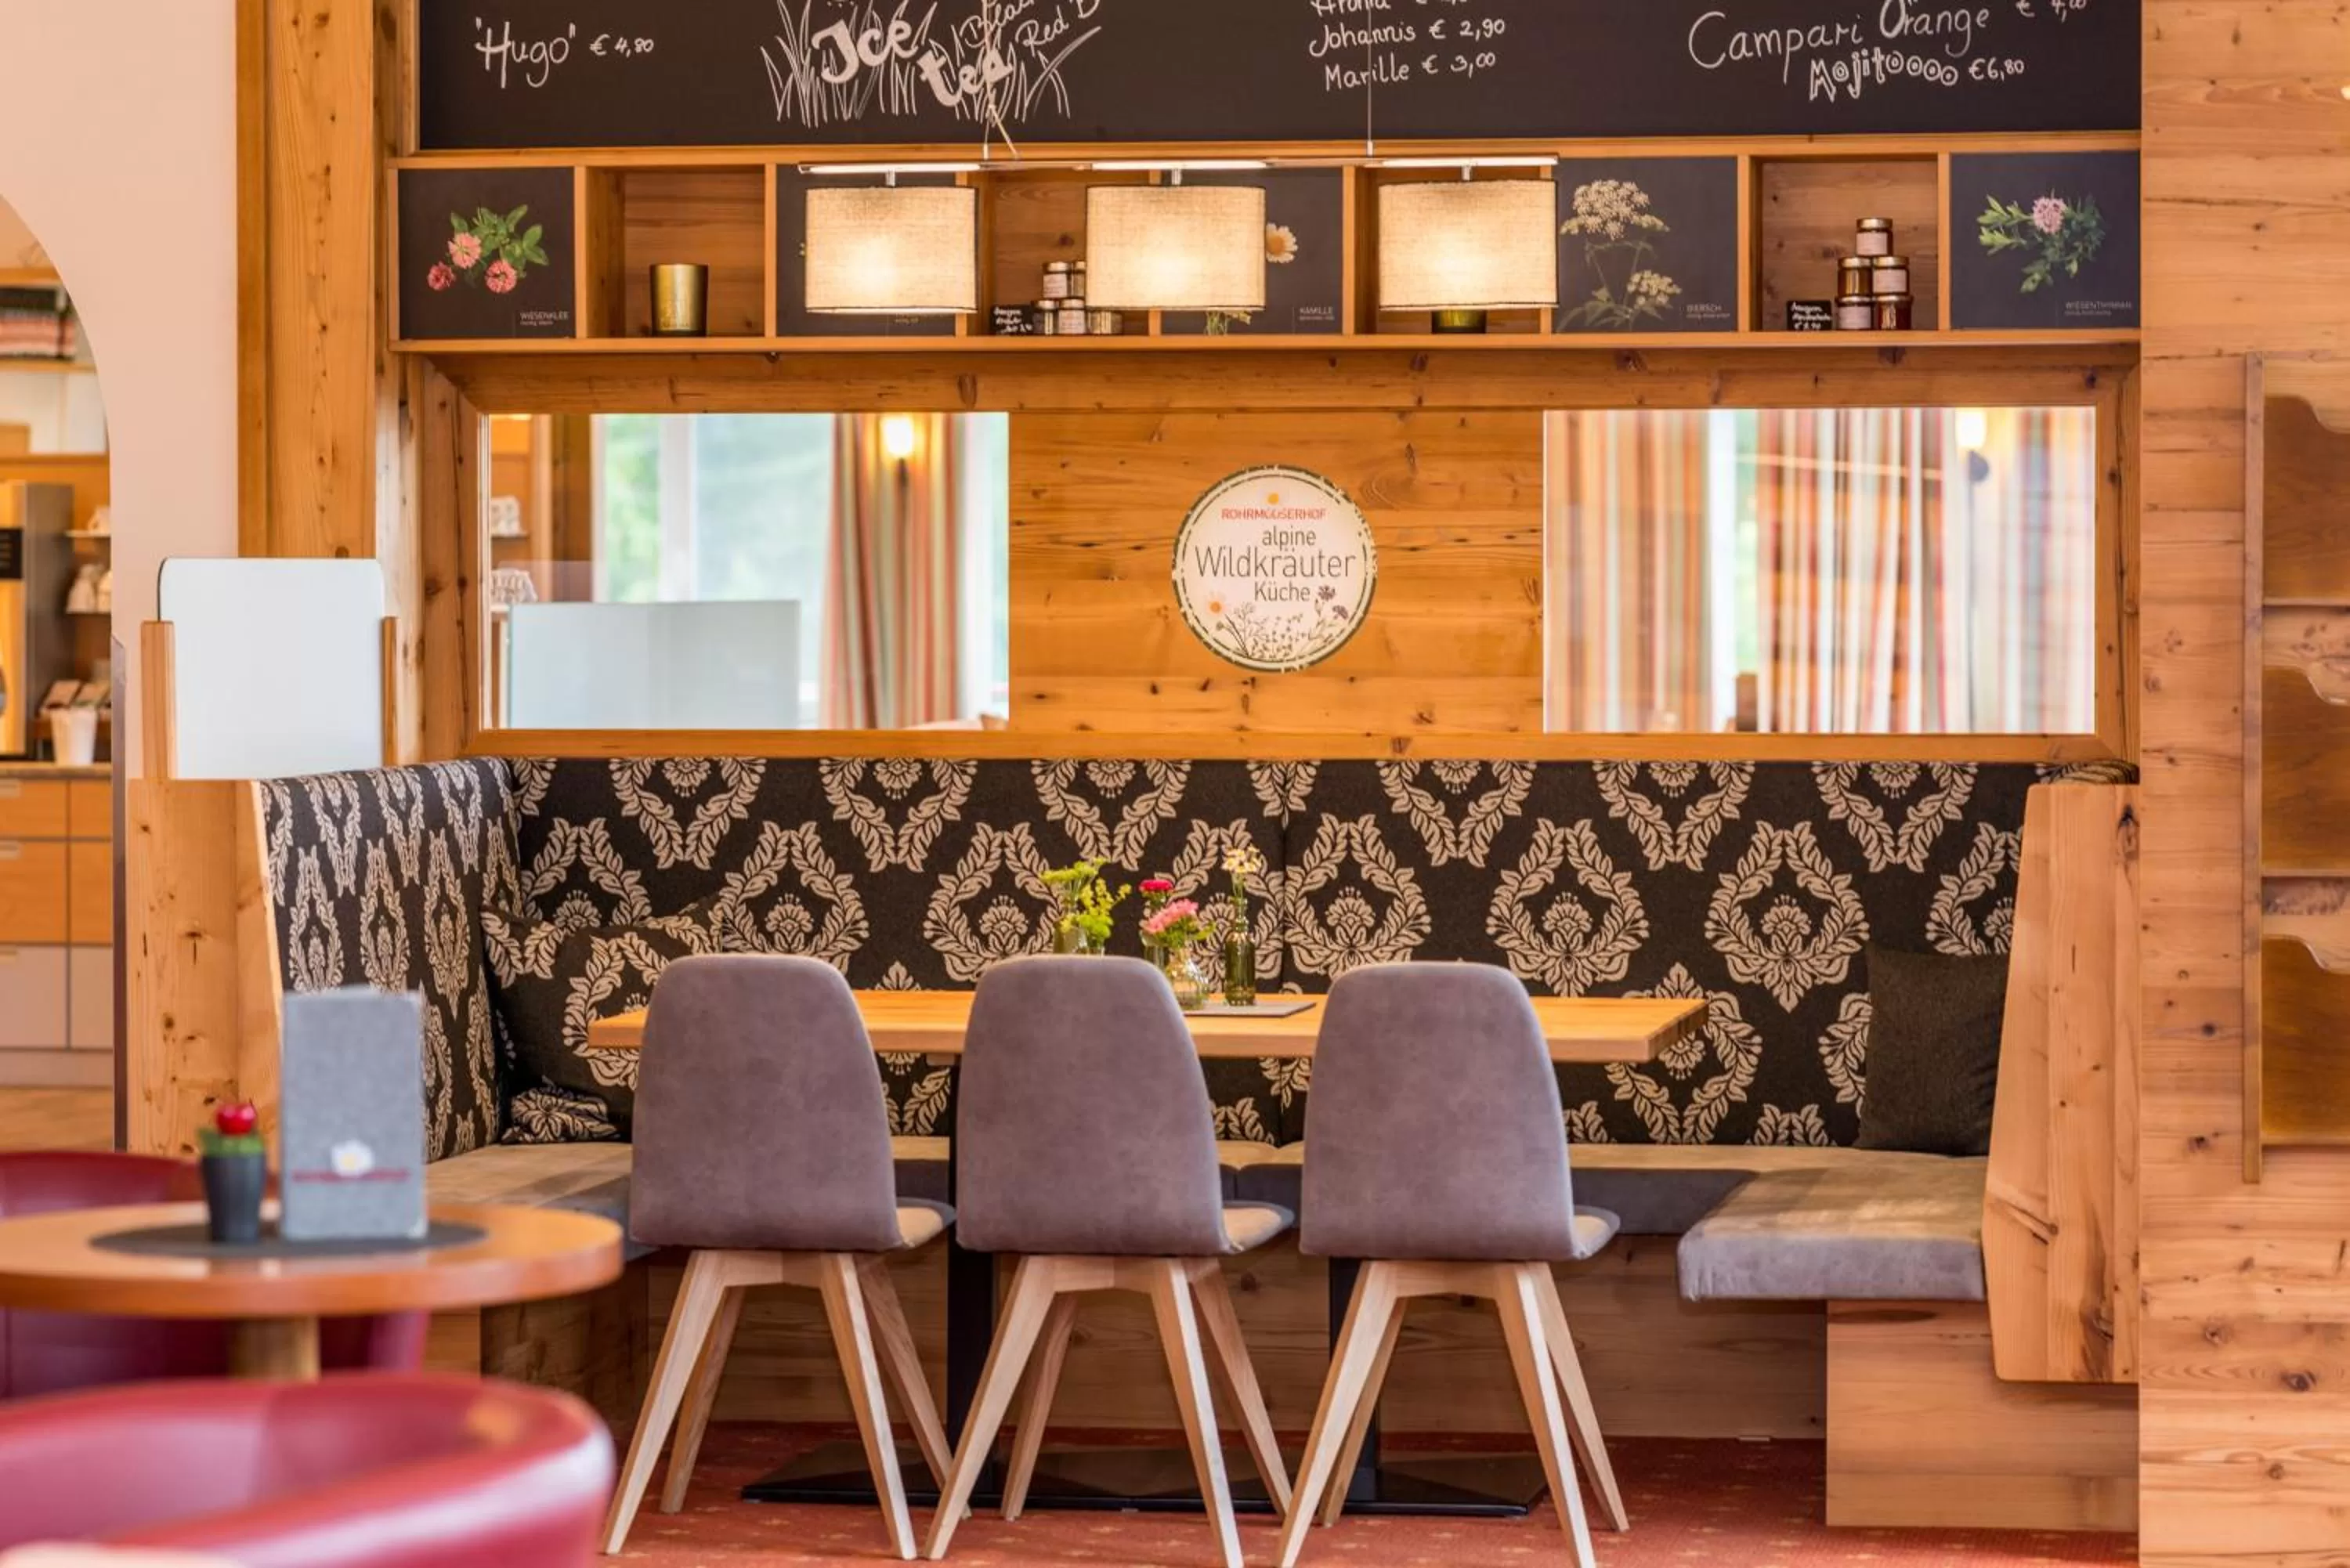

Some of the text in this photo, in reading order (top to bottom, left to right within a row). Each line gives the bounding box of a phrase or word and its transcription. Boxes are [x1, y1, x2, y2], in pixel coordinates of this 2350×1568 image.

[614, 37, 655, 58] 4,80
[1015, 20, 1070, 57] Red
[1309, 22, 1416, 57] Johannis
[1459, 18, 1506, 41] 2,90
[1688, 11, 1864, 85] Campari
[1880, 0, 1990, 57] Orange
[1325, 52, 1410, 92] Marille
[1450, 52, 1495, 78] 3,00
[1262, 525, 1317, 551] alpine
[1195, 545, 1356, 578] Wildkräuter
[1253, 582, 1311, 602] Küche
